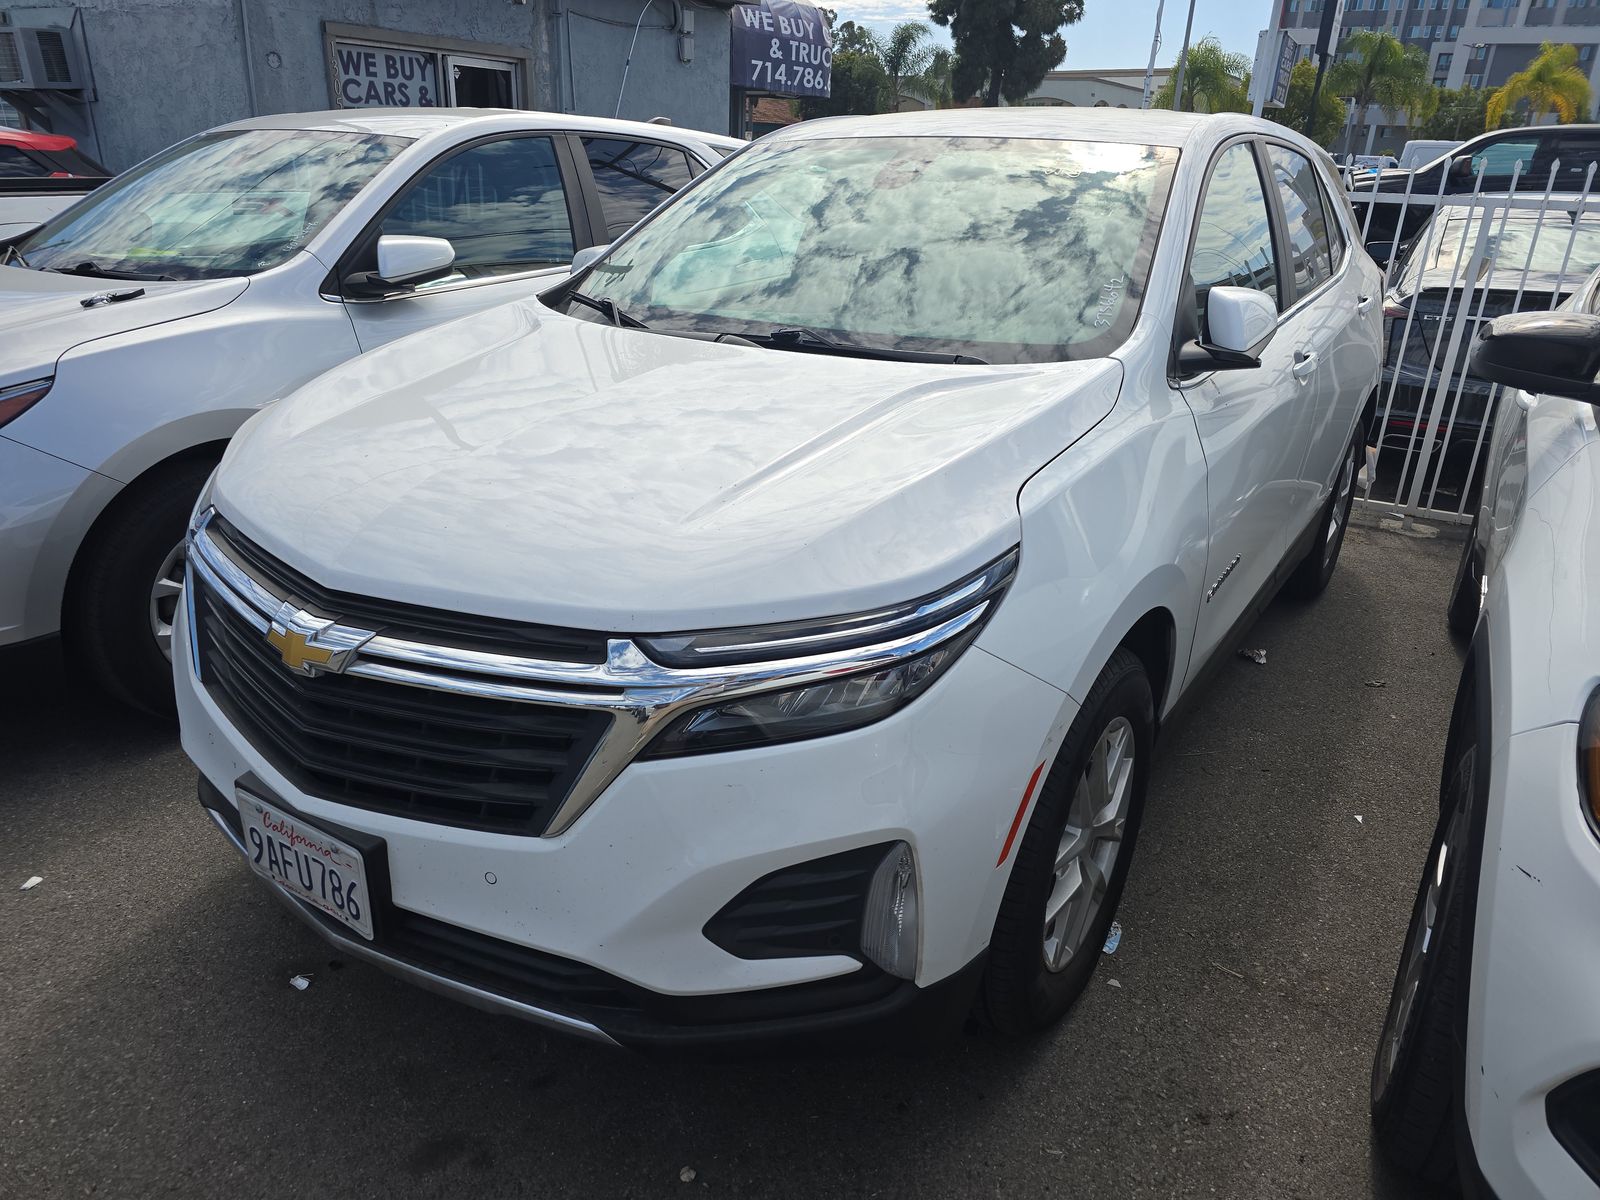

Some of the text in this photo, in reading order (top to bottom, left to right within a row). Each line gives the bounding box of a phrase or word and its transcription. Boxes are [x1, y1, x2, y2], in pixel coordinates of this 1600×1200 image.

[740, 5, 774, 32] WE
[779, 16, 814, 40] BUY
[337, 49, 430, 82] WE BUY
[769, 38, 783, 60] &
[342, 78, 434, 107] CARS &
[262, 811, 341, 865] California
[249, 826, 361, 921] 9AFU786
